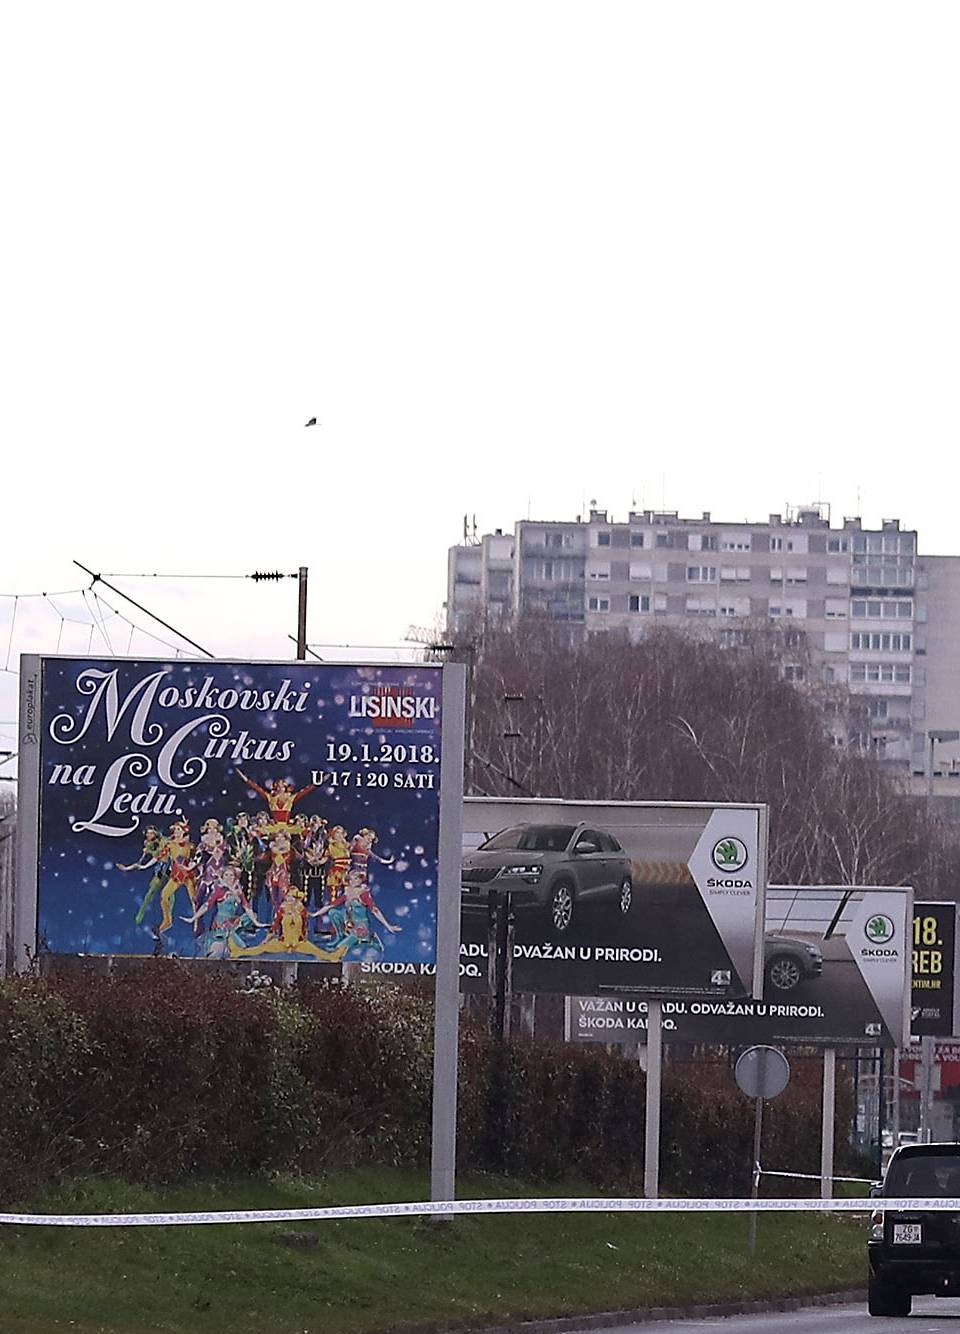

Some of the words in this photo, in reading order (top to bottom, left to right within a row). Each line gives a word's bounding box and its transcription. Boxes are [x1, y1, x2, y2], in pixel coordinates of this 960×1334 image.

[50, 668, 311, 746] Moskovski
[350, 695, 435, 718] LISINSKI
[157, 714, 294, 788] Cirkus
[326, 743, 440, 763] 19.1.2018.
[311, 771, 324, 785] U
[331, 772, 351, 786] 17
[355, 773, 362, 787] i
[367, 773, 388, 788] 20
[394, 773, 435, 789] SATI
[48, 763, 96, 785] na
[72, 753, 182, 837] Ledu.
[707, 878, 753, 888] ŠKODA
[498, 942, 576, 960] DVAŽAN
[580, 947, 591, 960] U
[595, 949, 662, 962] PRIRODI.
[626, 1001, 637, 1013] U
[691, 1001, 753, 1016] ODVAŽAN
[757, 1005, 766, 1016] U
[769, 1006, 825, 1018] PRIRODI.
[579, 1015, 624, 1029] ŠKODA
